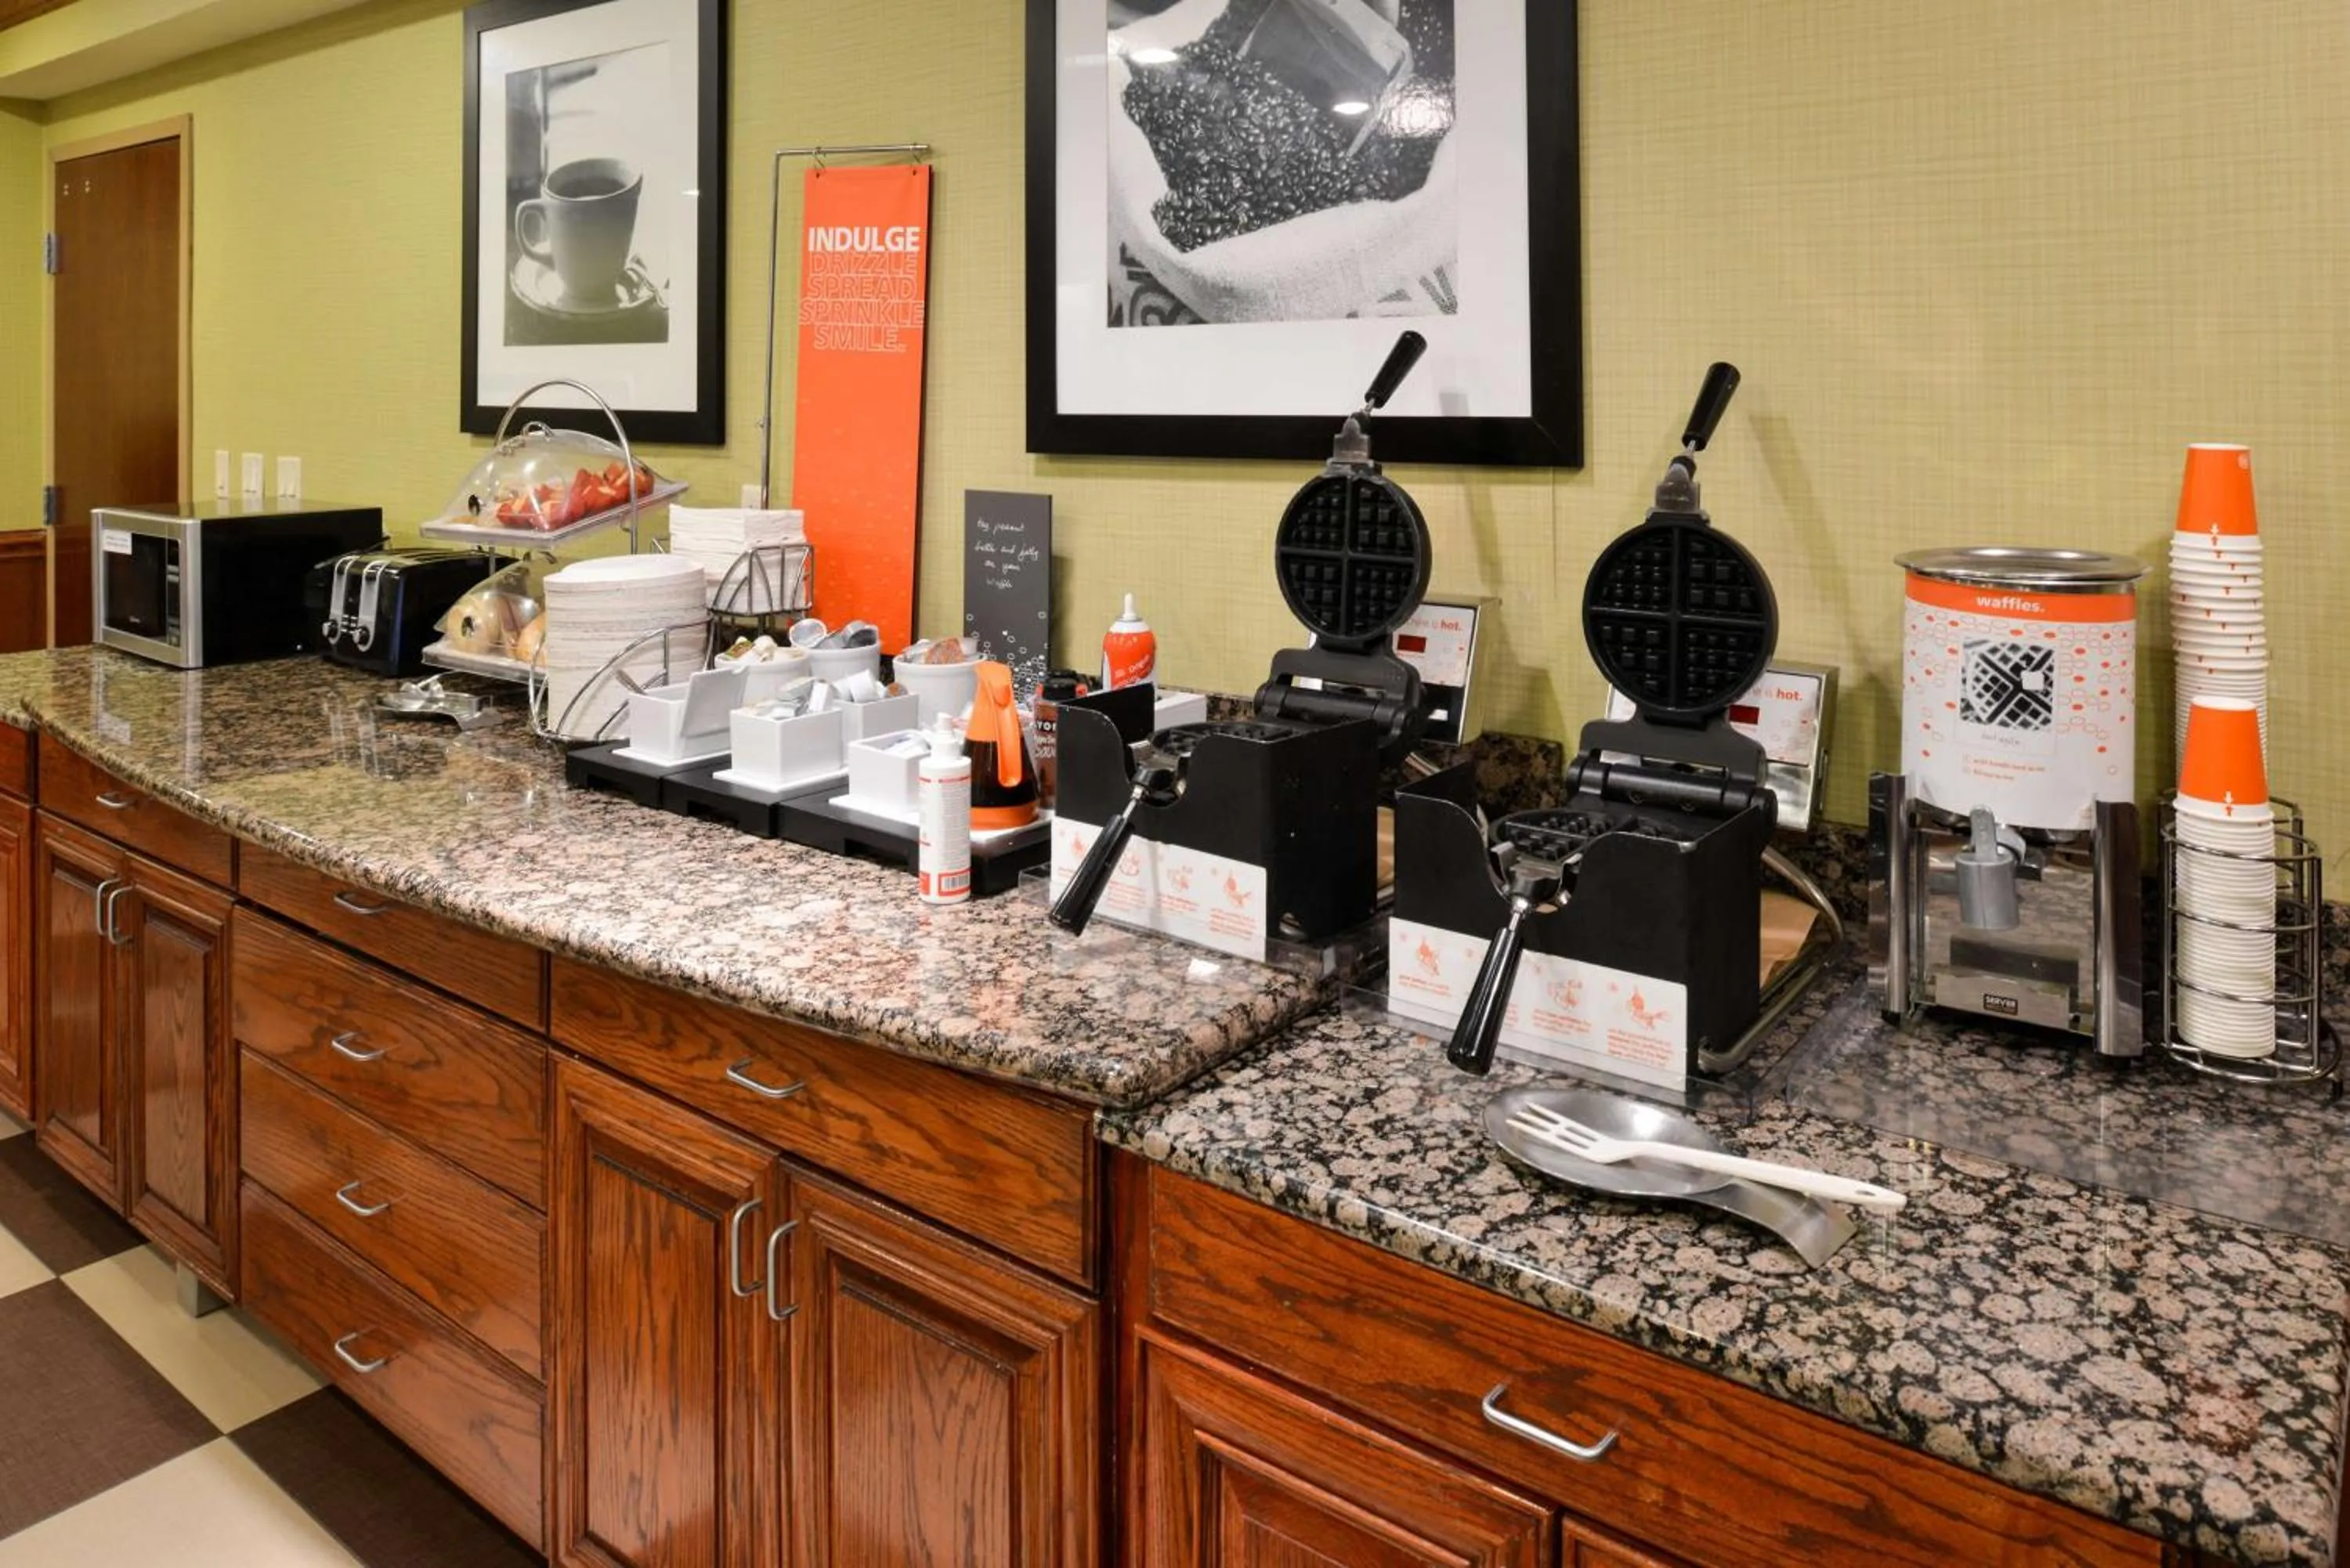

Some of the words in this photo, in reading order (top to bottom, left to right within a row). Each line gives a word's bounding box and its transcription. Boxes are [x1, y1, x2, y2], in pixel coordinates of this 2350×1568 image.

[808, 226, 920, 251] INDULGE
[810, 252, 917, 276] DRIZZLE
[807, 274, 916, 300] SPREAD
[798, 299, 924, 327] SPRINKLE
[813, 325, 906, 352] SMILE.
[1976, 594, 2045, 612] waffles.
[1777, 688, 1803, 702] hot.
